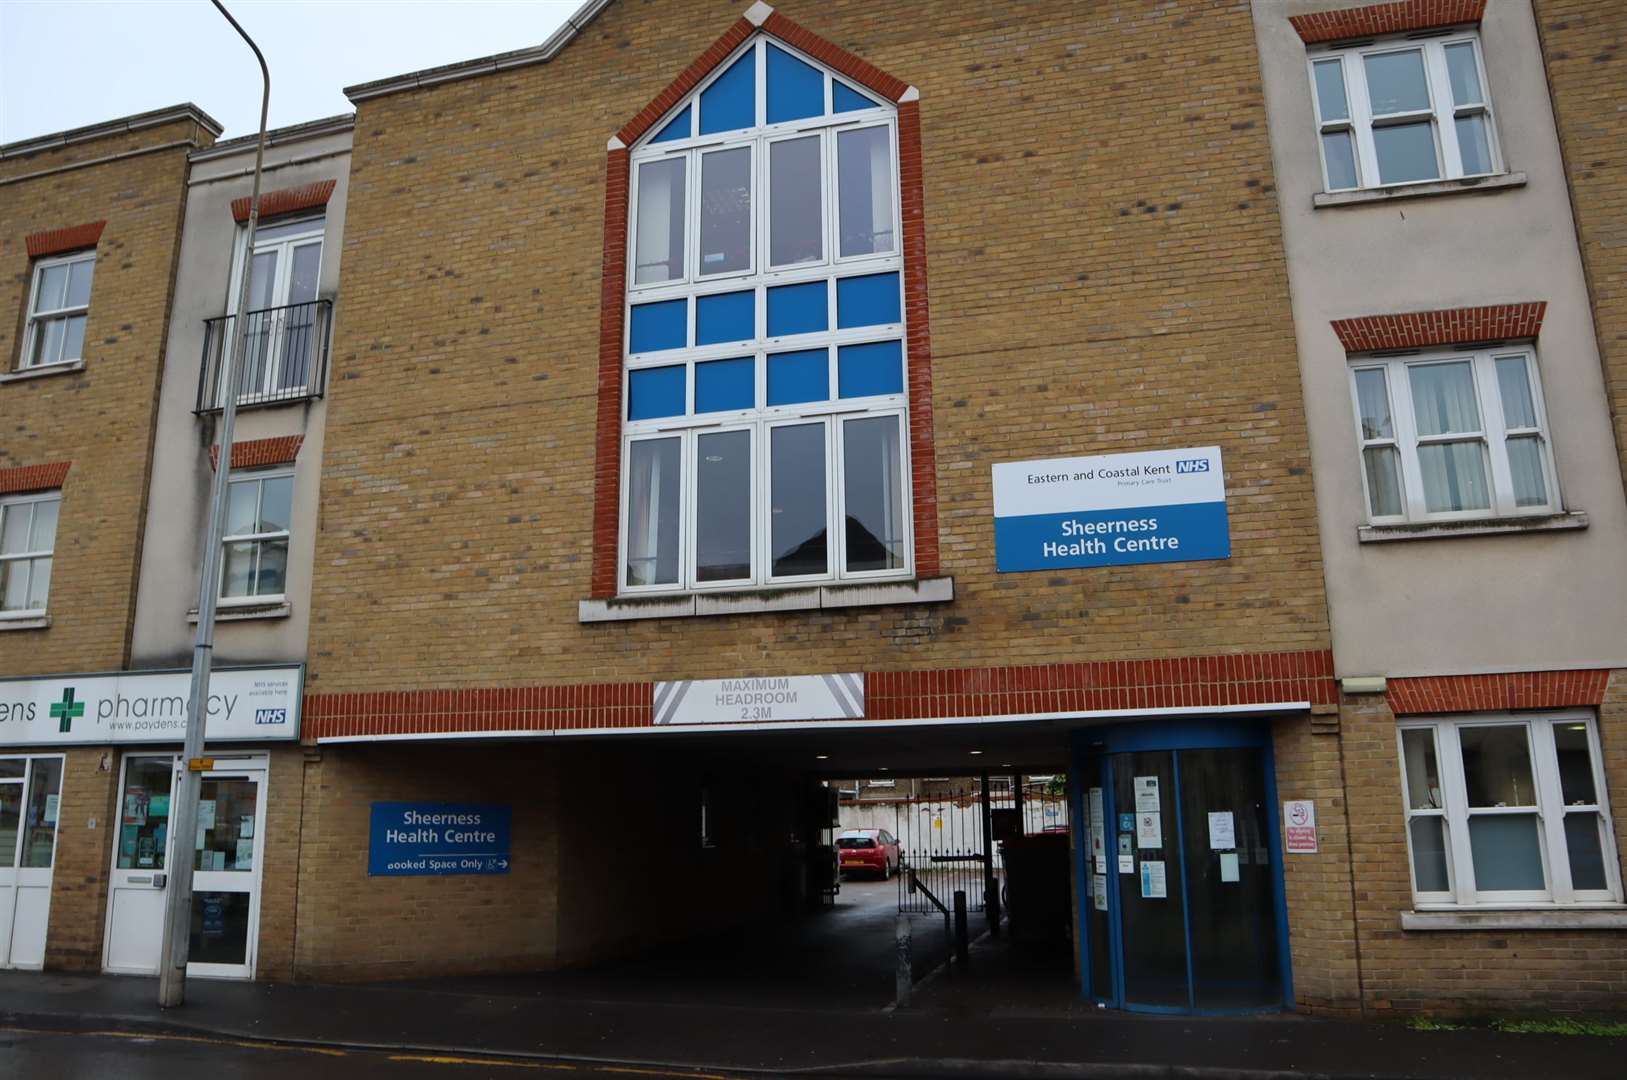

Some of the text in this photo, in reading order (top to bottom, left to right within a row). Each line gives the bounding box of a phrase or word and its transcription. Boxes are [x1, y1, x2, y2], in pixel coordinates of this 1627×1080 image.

[1027, 459, 1208, 485] Eastern and Coastal Kent NHS
[1061, 518, 1158, 536] Sheerness
[1043, 536, 1179, 557] Health Centre
[721, 678, 789, 692] MAXIMUM
[715, 692, 797, 706] HEADROOM
[97, 693, 239, 724] pharmcy
[741, 707, 772, 719] 2.3M
[256, 709, 285, 723] NHS
[403, 810, 481, 825] Sheerness
[386, 829, 496, 843] Health Centre
[429, 860, 457, 870] Space
[460, 859, 482, 870] Only
